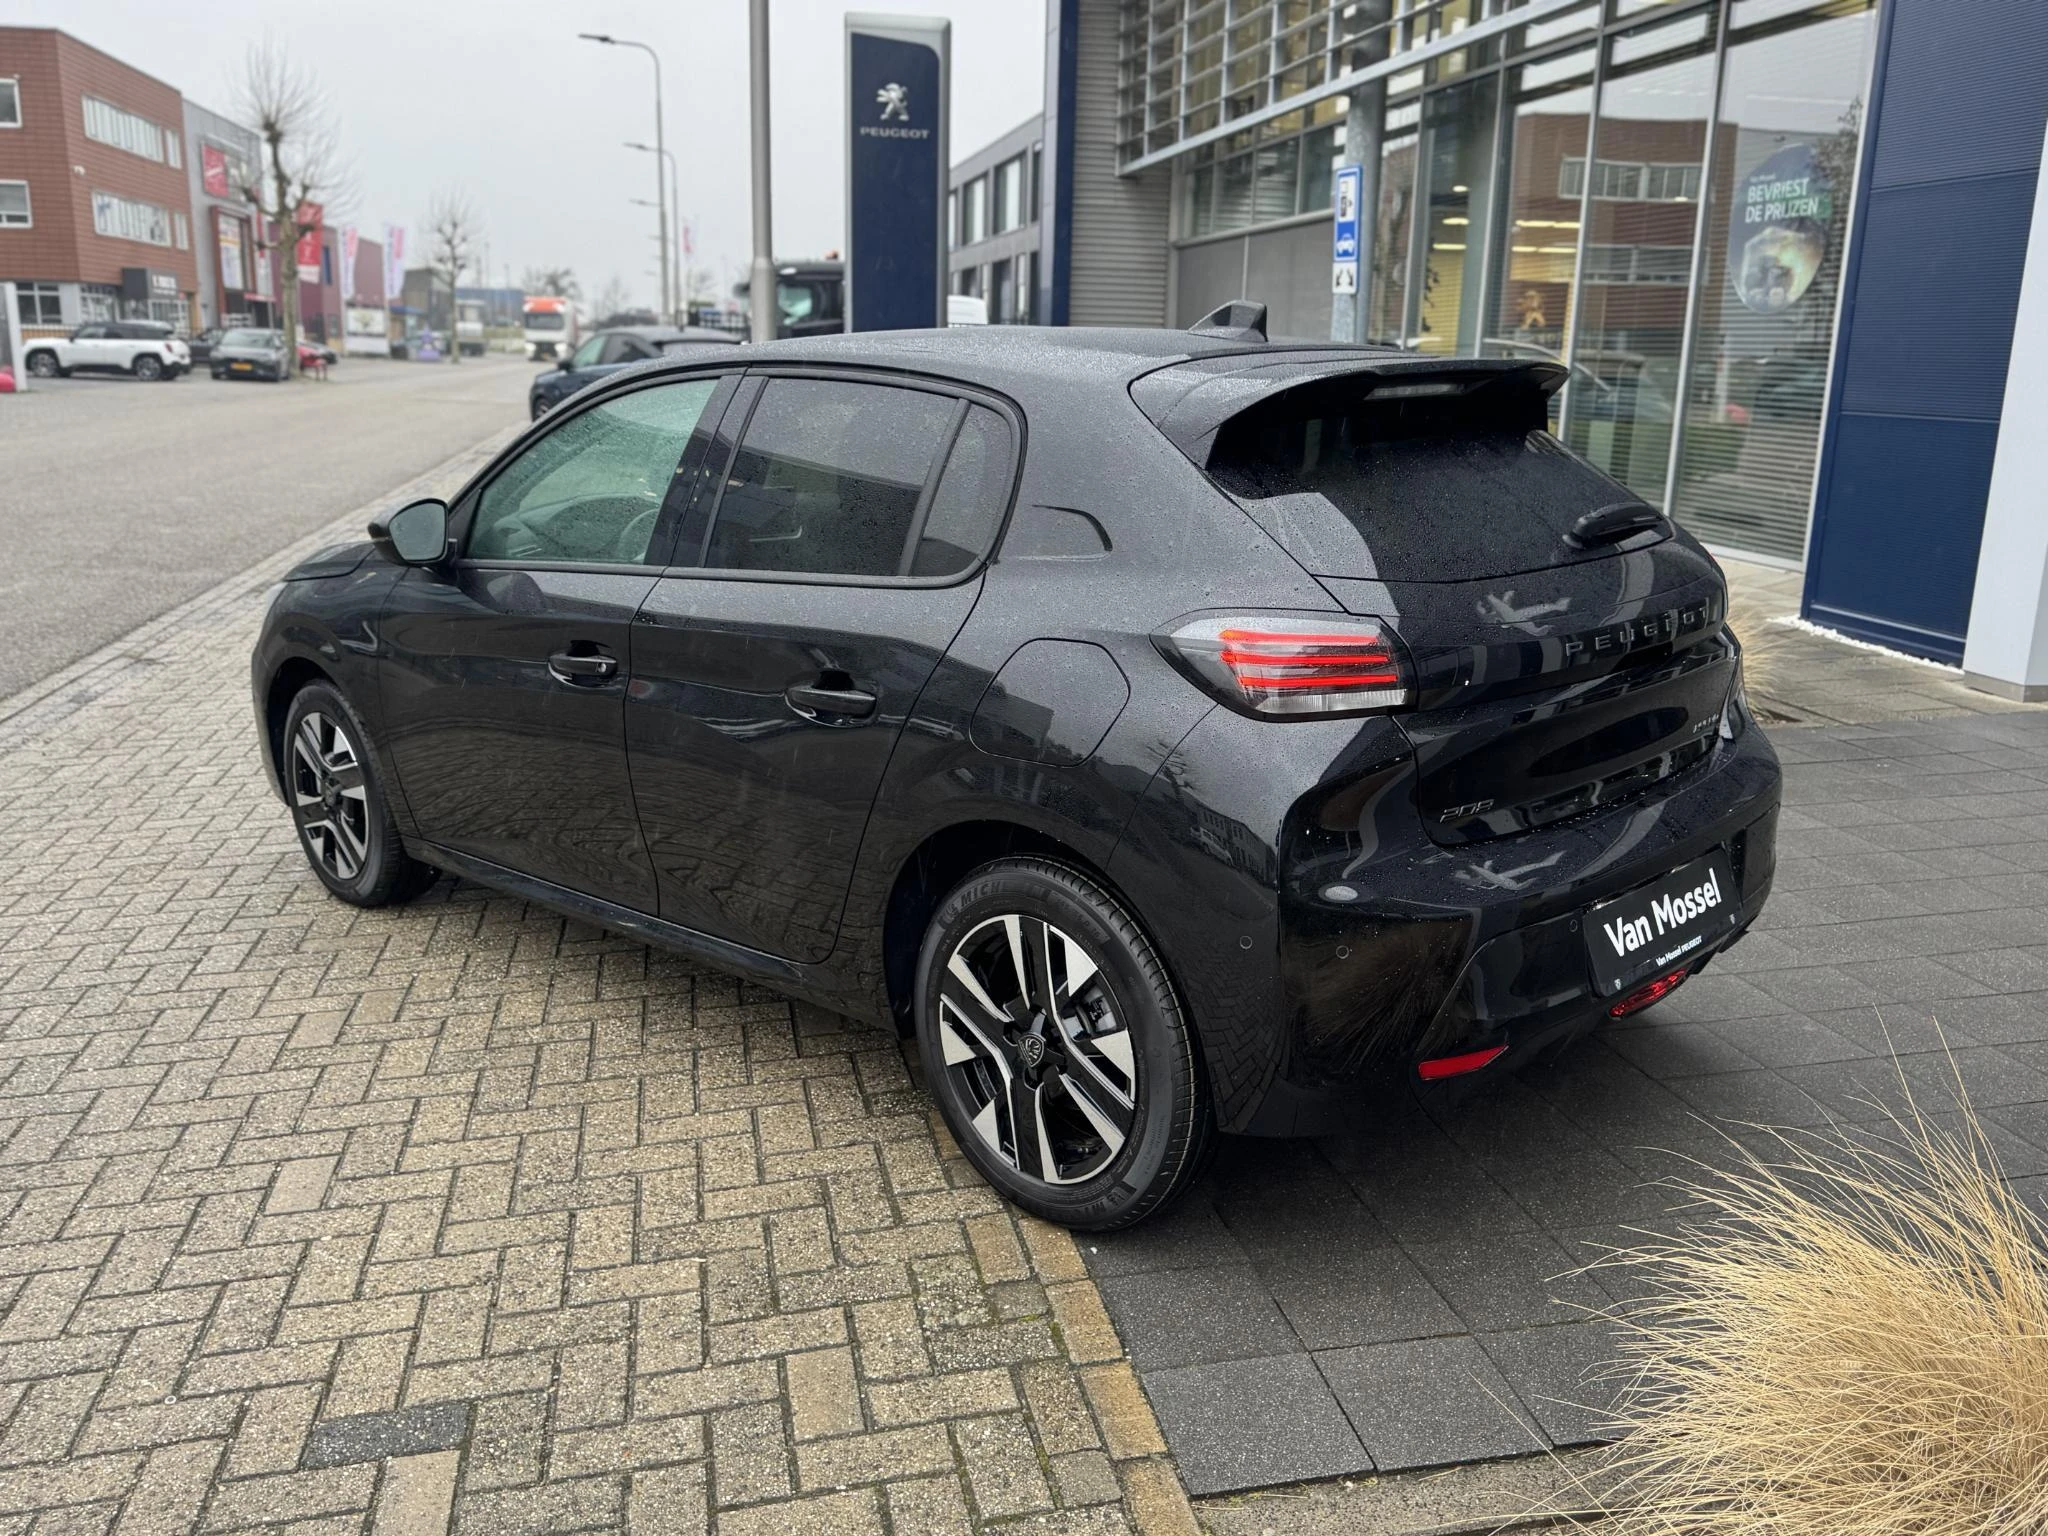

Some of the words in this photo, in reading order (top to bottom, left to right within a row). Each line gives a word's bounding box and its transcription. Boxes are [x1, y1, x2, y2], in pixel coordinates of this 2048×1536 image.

[860, 126, 930, 139] PEUGEOT
[1747, 178, 1810, 203] BEVRIEST
[1745, 204, 1763, 223] DE
[1764, 197, 1819, 221] PRIJZEN
[1566, 606, 1708, 656] PEUGEOT
[1603, 917, 1653, 957] Van
[1651, 867, 1722, 935] Mossel
